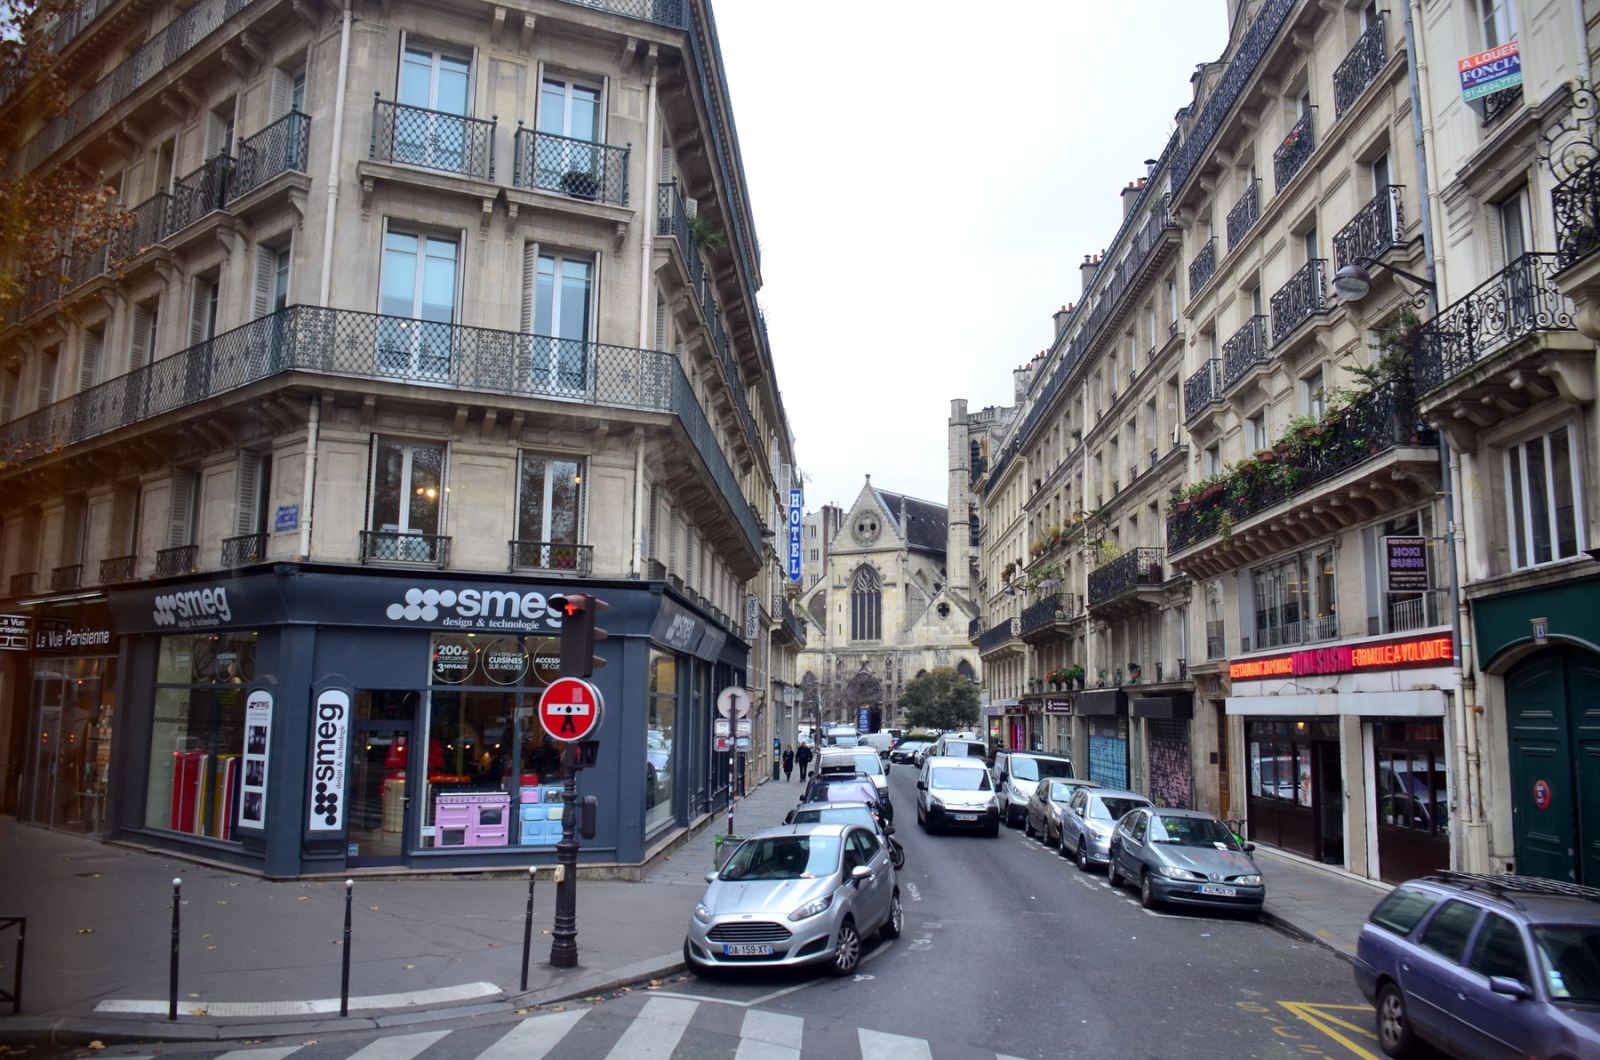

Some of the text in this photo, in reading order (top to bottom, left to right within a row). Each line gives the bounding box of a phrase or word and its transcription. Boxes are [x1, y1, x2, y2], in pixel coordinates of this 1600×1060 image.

[1476, 44, 1519, 66] LOUER
[1461, 54, 1520, 82] FONCIA
[791, 493, 800, 574] HOTEL
[1391, 558, 1424, 568] SUSHI
[176, 587, 231, 621] smeg
[11, 618, 26, 626] Vue
[443, 617, 540, 631] design & technologie
[36, 627, 110, 648] La Vue Parisienne
[438, 645, 462, 656] 200
[437, 663, 444, 673] 3
[488, 656, 523, 664] CUISINES
[315, 704, 344, 782] smeg
